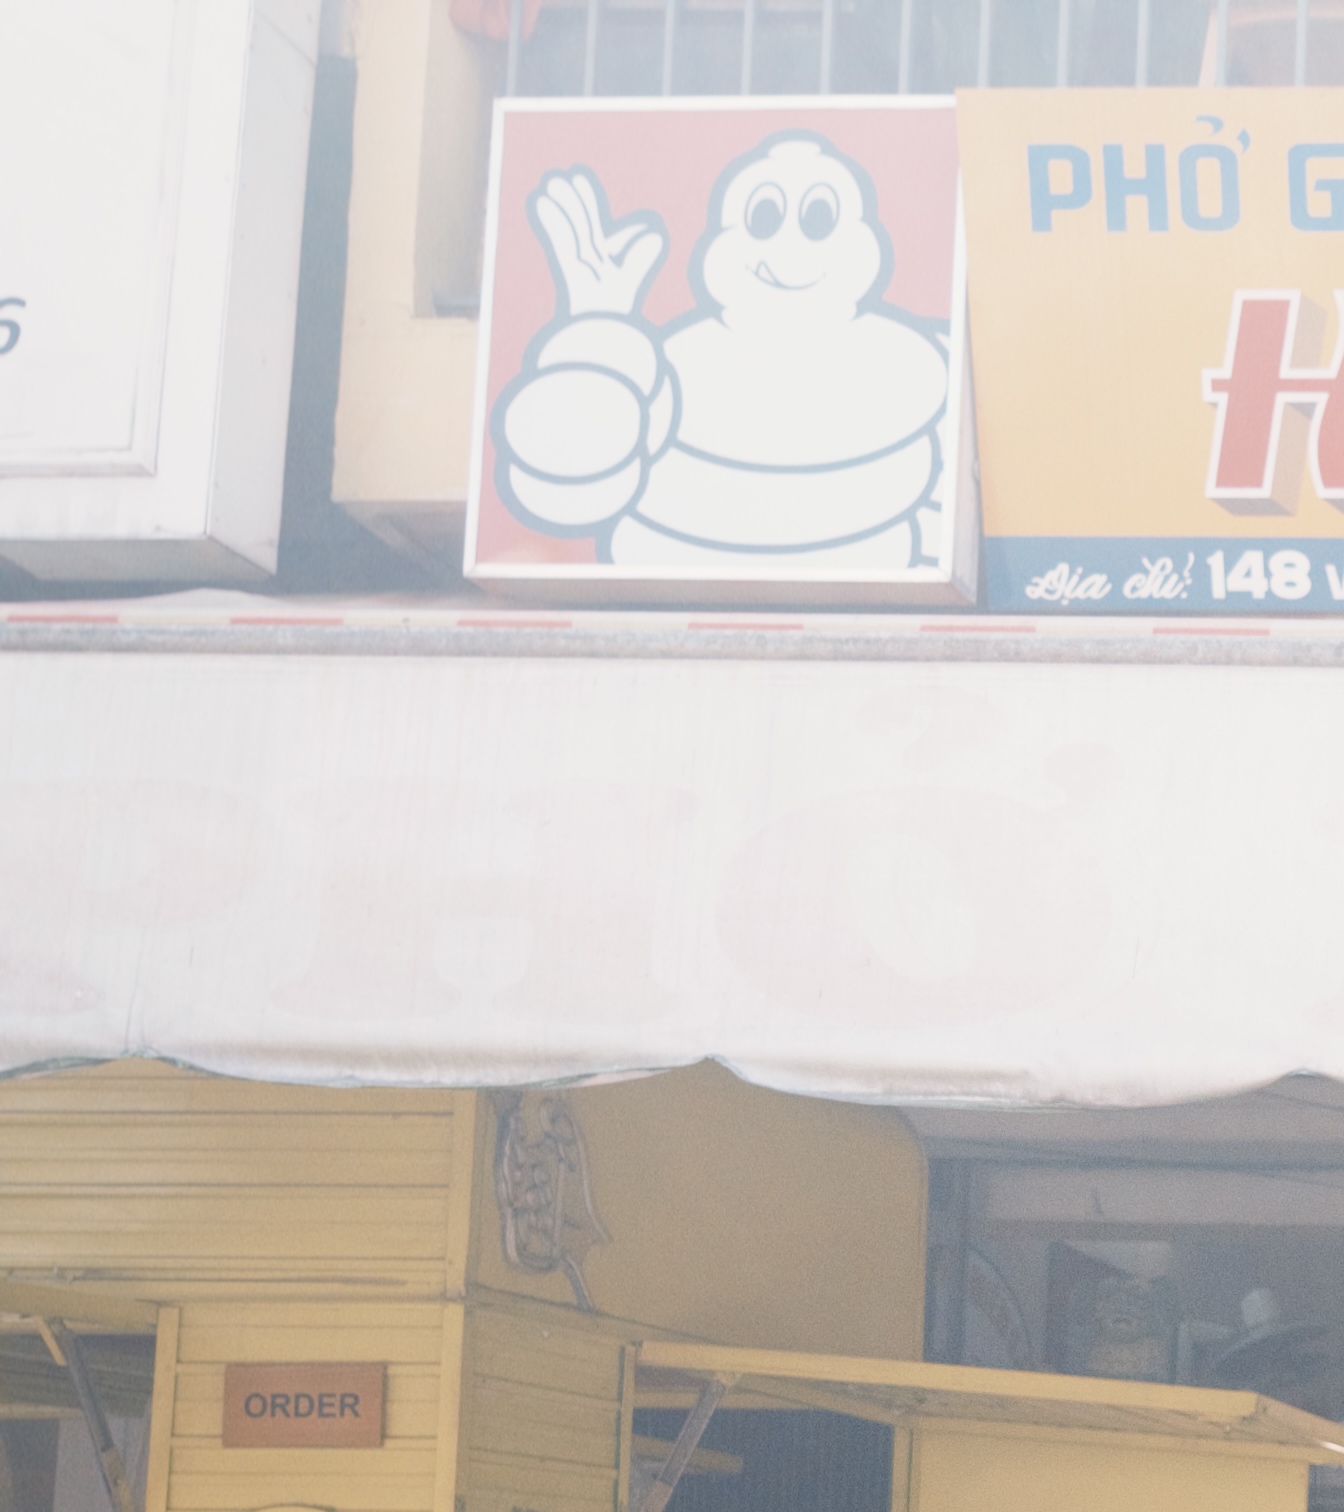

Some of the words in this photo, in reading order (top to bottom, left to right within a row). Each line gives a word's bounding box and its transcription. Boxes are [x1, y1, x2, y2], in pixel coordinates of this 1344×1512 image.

[1027, 115, 1251, 233] PHỞ
[1024, 562, 1113, 606] Địa
[1206, 550, 1312, 600] 148
[243, 1391, 361, 1420] ORDER
